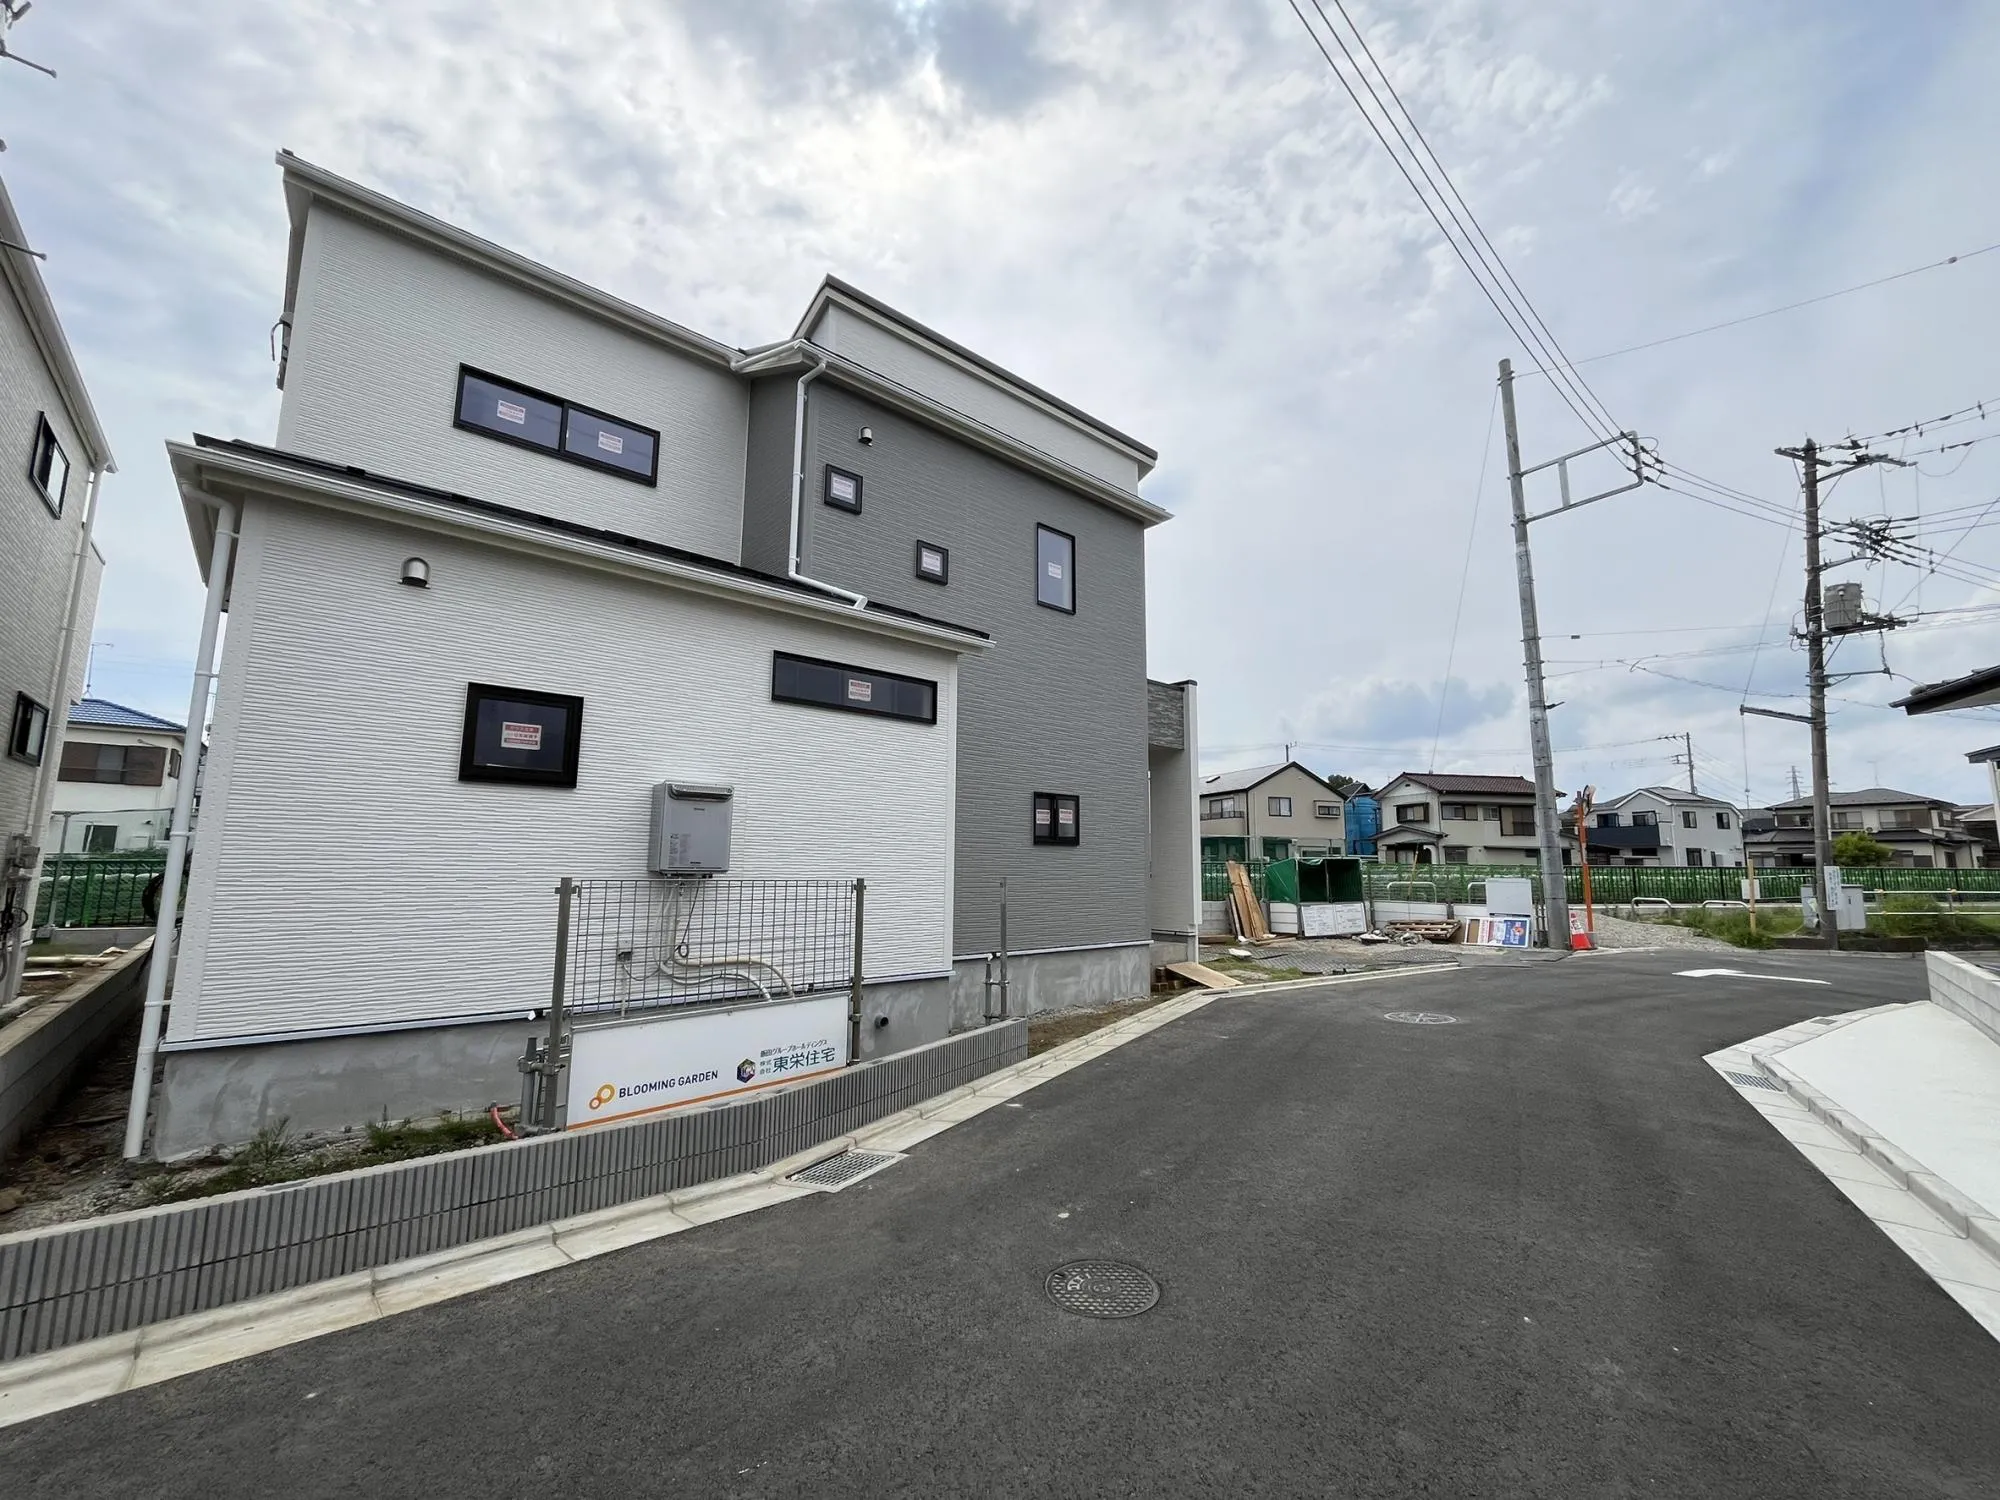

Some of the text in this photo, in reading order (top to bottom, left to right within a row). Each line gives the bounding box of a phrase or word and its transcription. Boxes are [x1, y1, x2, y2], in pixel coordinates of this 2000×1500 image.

[773, 1047, 836, 1073] 東栄住宅
[619, 1078, 676, 1098] BLOOMING
[678, 1070, 719, 1086] GARDEN
